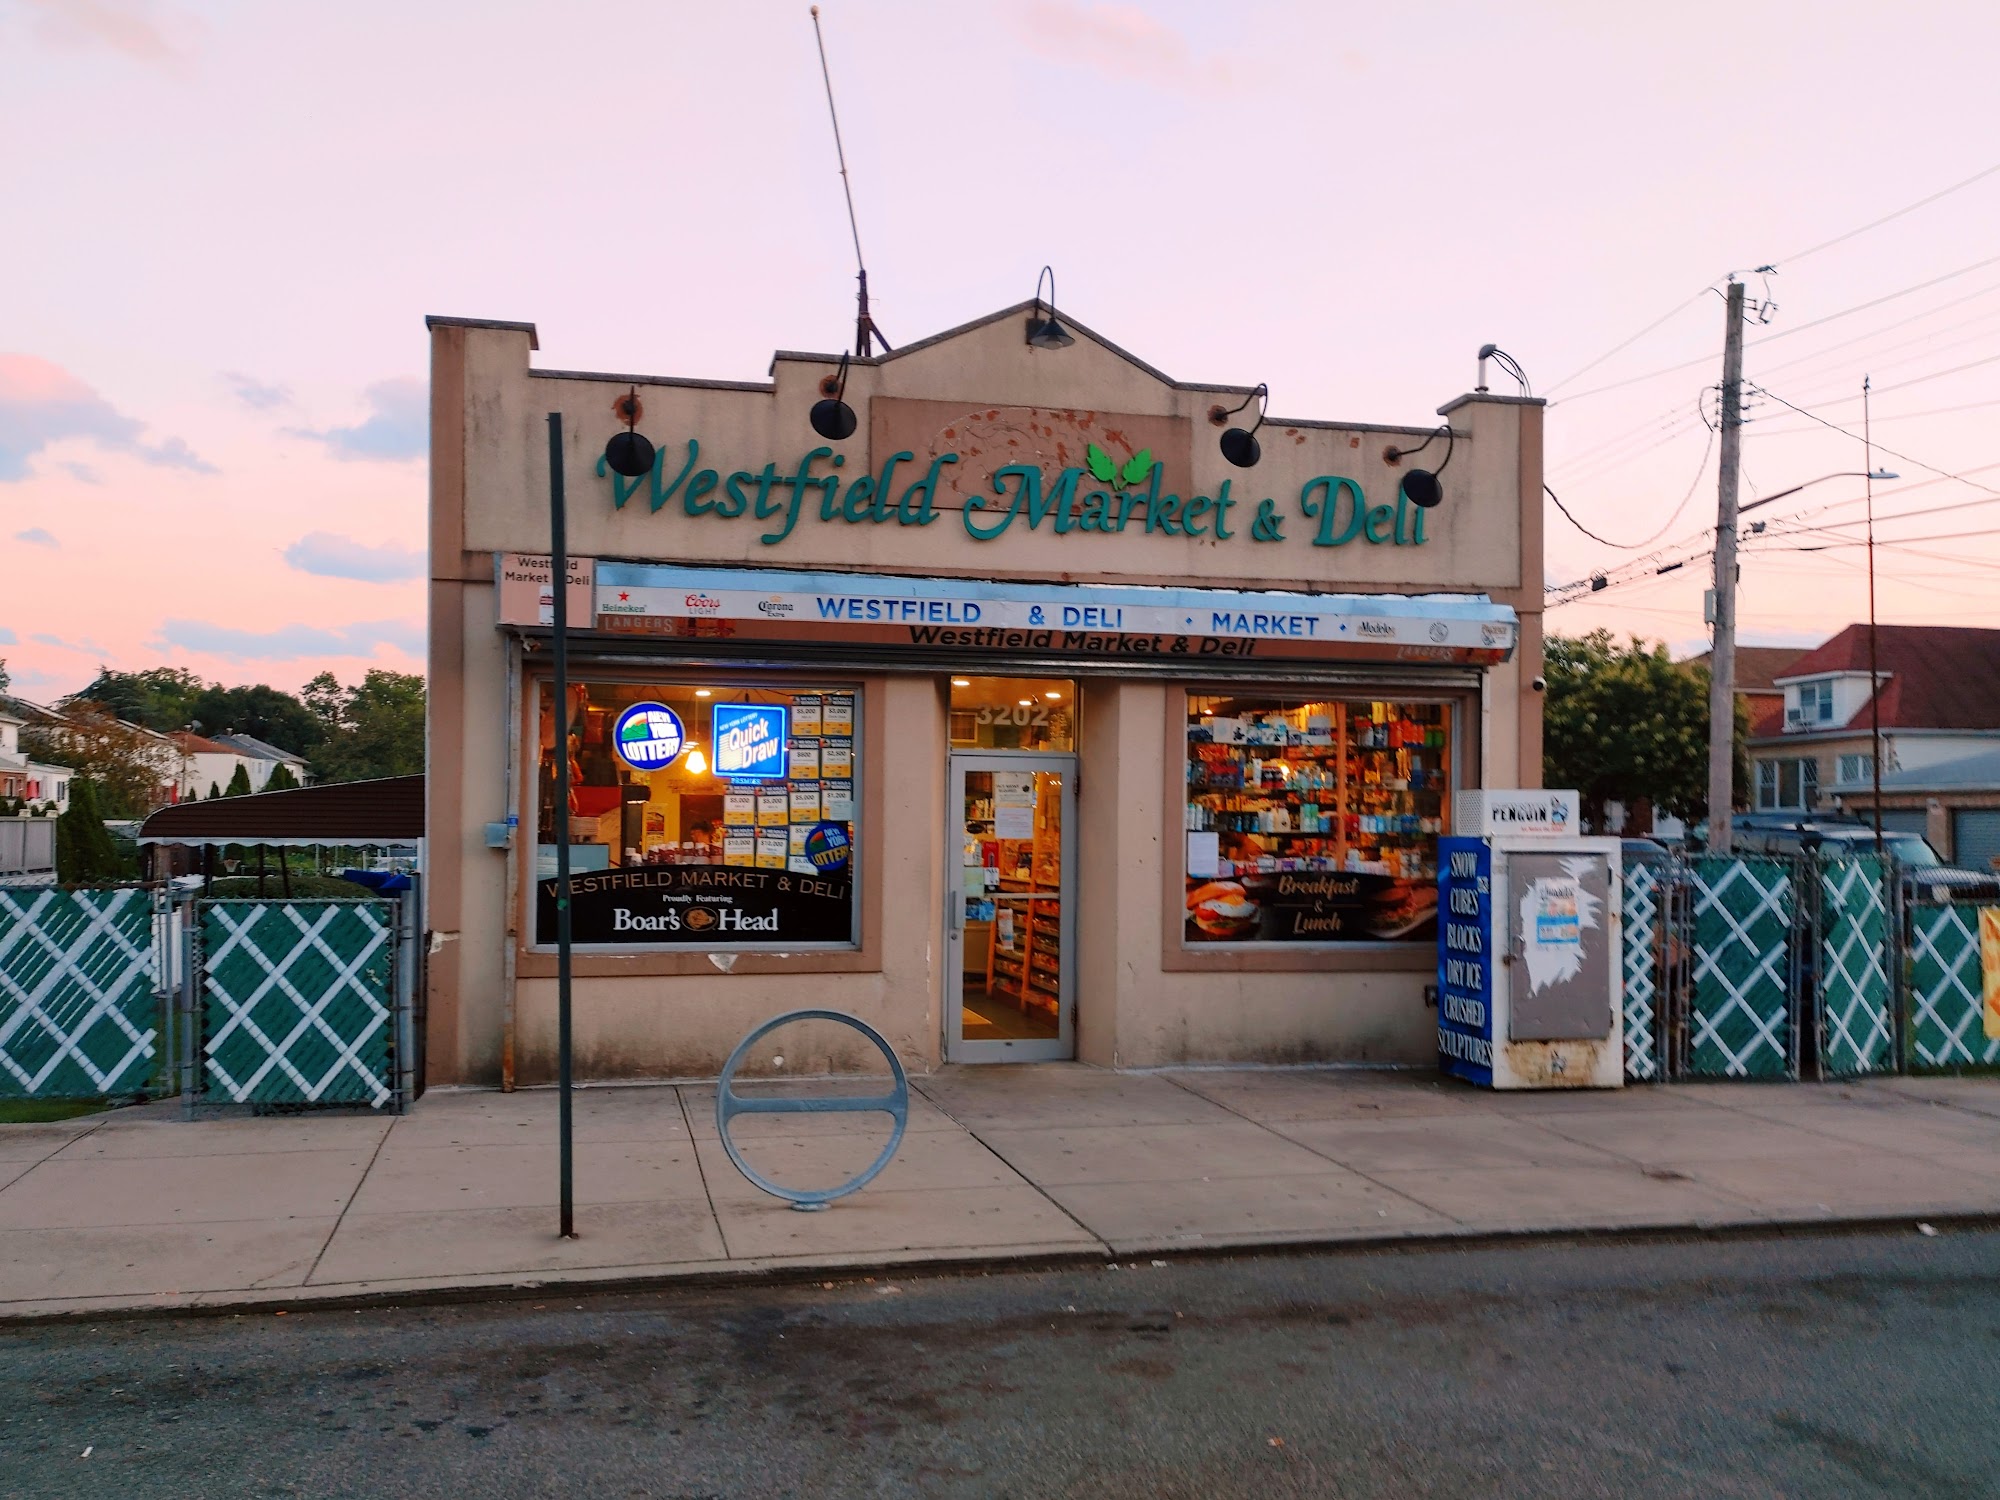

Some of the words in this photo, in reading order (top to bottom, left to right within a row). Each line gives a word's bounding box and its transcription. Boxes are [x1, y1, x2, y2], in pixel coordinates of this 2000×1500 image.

[596, 438, 958, 545] Westfield
[963, 461, 1235, 541] Market
[1251, 497, 1287, 542] &
[517, 557, 578, 570] Westld
[504, 571, 549, 583] Market
[602, 603, 646, 613] Heineken
[685, 594, 721, 608] Coors
[689, 607, 717, 615] LIGHT
[758, 600, 794, 612] Corona
[816, 597, 981, 623] WESTFIELD
[1028, 605, 1045, 626] &
[1063, 606, 1122, 628] DELI
[605, 616, 674, 632] LANGERS
[1212, 612, 1320, 636] MARKET
[909, 625, 1050, 648] Westfield
[1061, 631, 1163, 651] Market
[1169, 635, 1190, 653] &
[1200, 637, 1257, 656] Deli
[976, 704, 1049, 726] 3202
[729, 717, 769, 751] Quick
[621, 738, 680, 761] LOTTERY
[742, 737, 779, 769] Draw
[824, 828, 841, 840] NEW
[1450, 851, 1478, 878] SNOW
[681, 871, 769, 889] MARKET
[777, 876, 792, 892] &
[799, 879, 845, 900] DELI
[1279, 875, 1360, 900] Breakfast
[662, 894, 692, 903] Proudly
[696, 895, 733, 904] Featuring
[1314, 900, 1323, 913] &
[1450, 887, 1479, 916] CUBES
[613, 907, 681, 931] Boar's
[717, 907, 779, 931] Head
[1292, 912, 1342, 934] Lunch
[1446, 922, 1482, 953] BLOCKS
[1447, 958, 1465, 988] DRY
[1466, 962, 1483, 991] ICE
[1444, 993, 1485, 1028] CRUSHED
[1437, 1027, 1492, 1068] SCULPTURES
